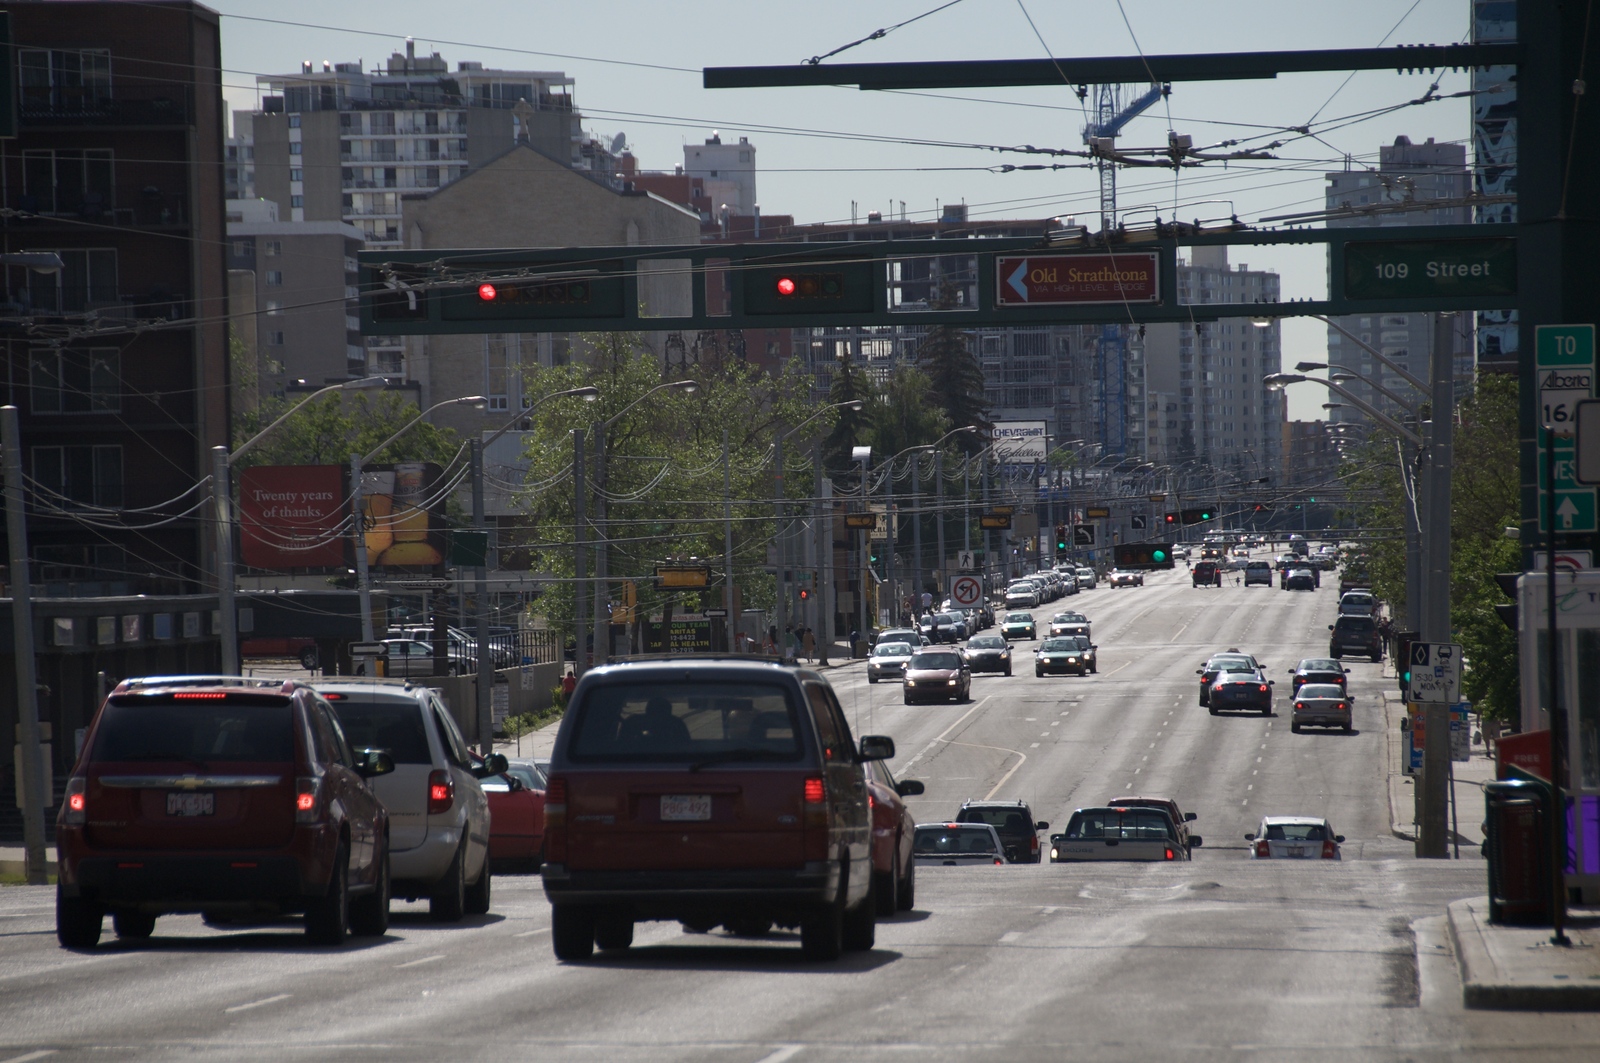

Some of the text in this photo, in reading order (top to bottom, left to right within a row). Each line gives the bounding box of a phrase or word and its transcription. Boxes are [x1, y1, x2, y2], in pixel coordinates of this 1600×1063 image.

[1030, 266, 1149, 283] Old Strathcona
[1375, 261, 1490, 279] 109 Street
[1033, 282, 1146, 293] VIA HIGH LEVEL BRIDGE
[1554, 335, 1577, 355] TO
[1541, 370, 1590, 388] Alberta
[253, 489, 333, 504] Twenty years
[262, 505, 324, 518] of thanks.
[1514, 754, 1540, 763] FREE
